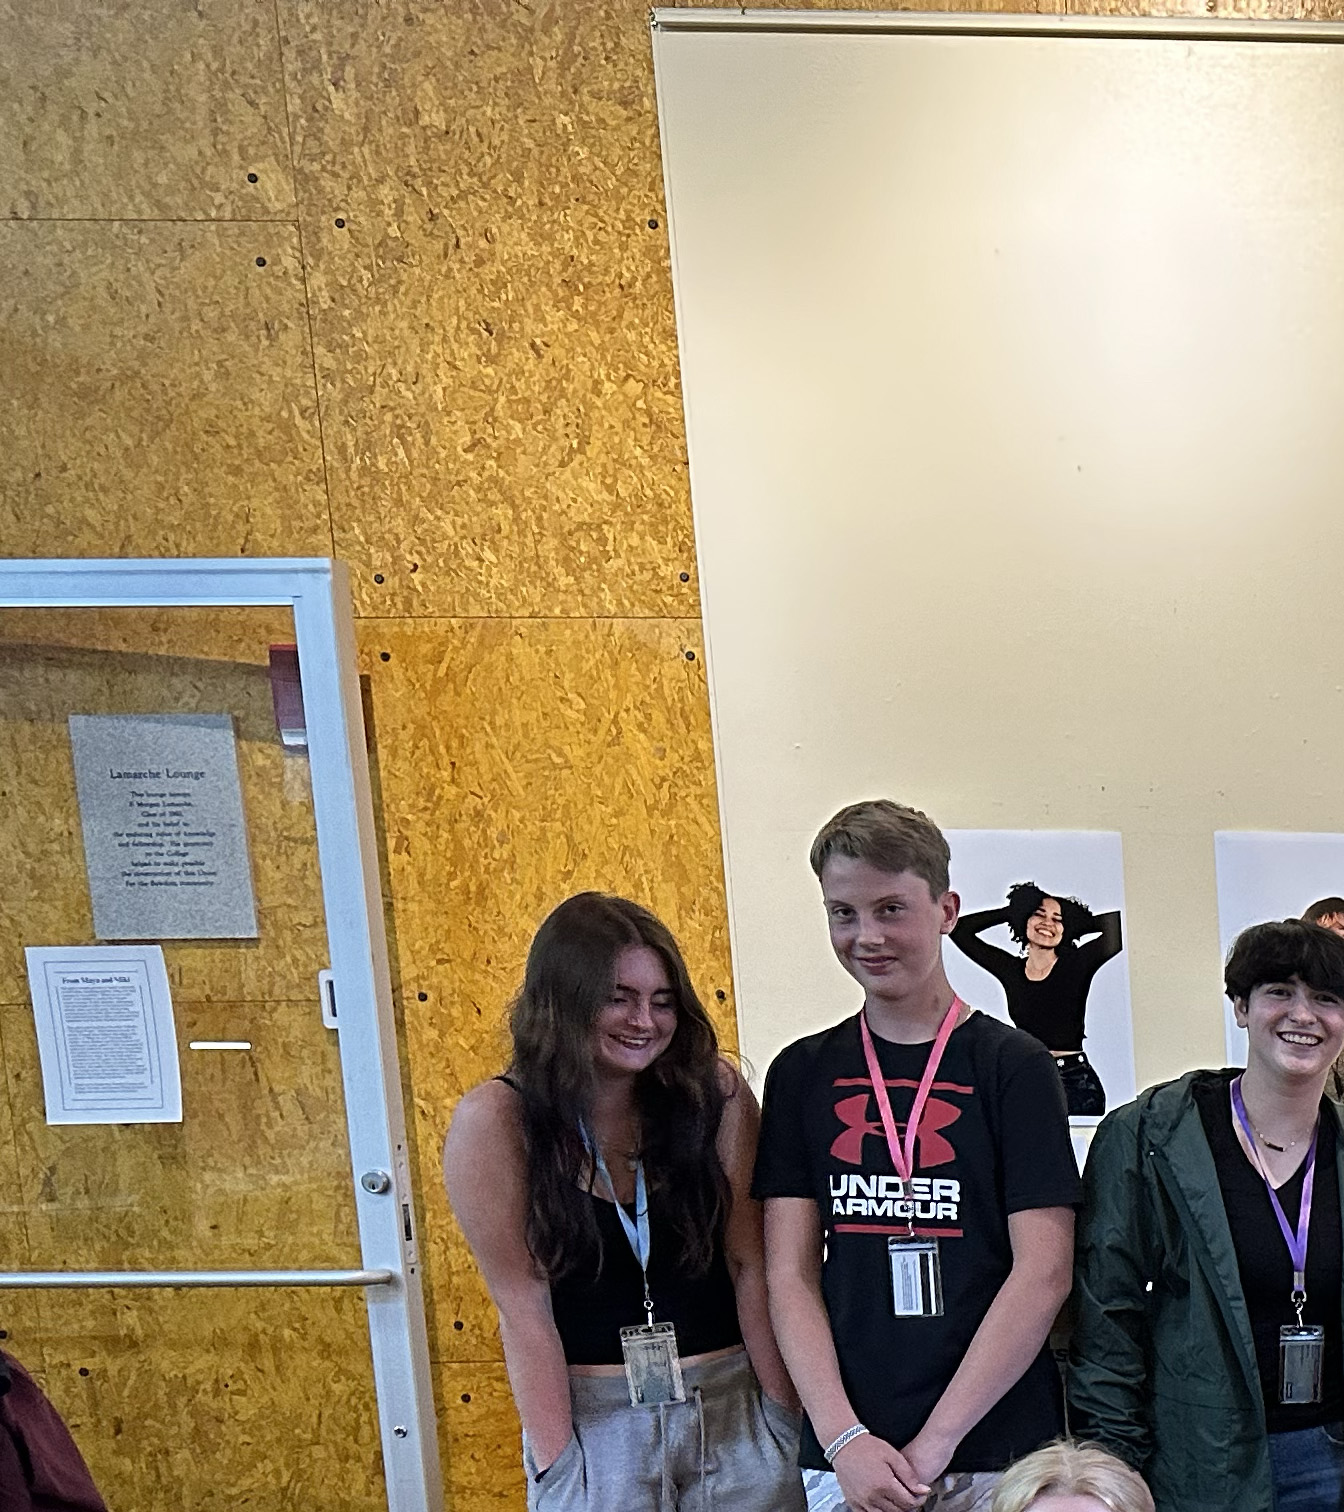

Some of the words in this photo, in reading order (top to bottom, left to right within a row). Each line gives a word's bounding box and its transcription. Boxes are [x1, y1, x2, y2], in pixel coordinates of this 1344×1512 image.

[110, 768, 160, 779] Lamarche
[166, 768, 205, 780] Lounge
[829, 1174, 960, 1202] UNDER
[832, 1198, 958, 1220] ARMOUR
